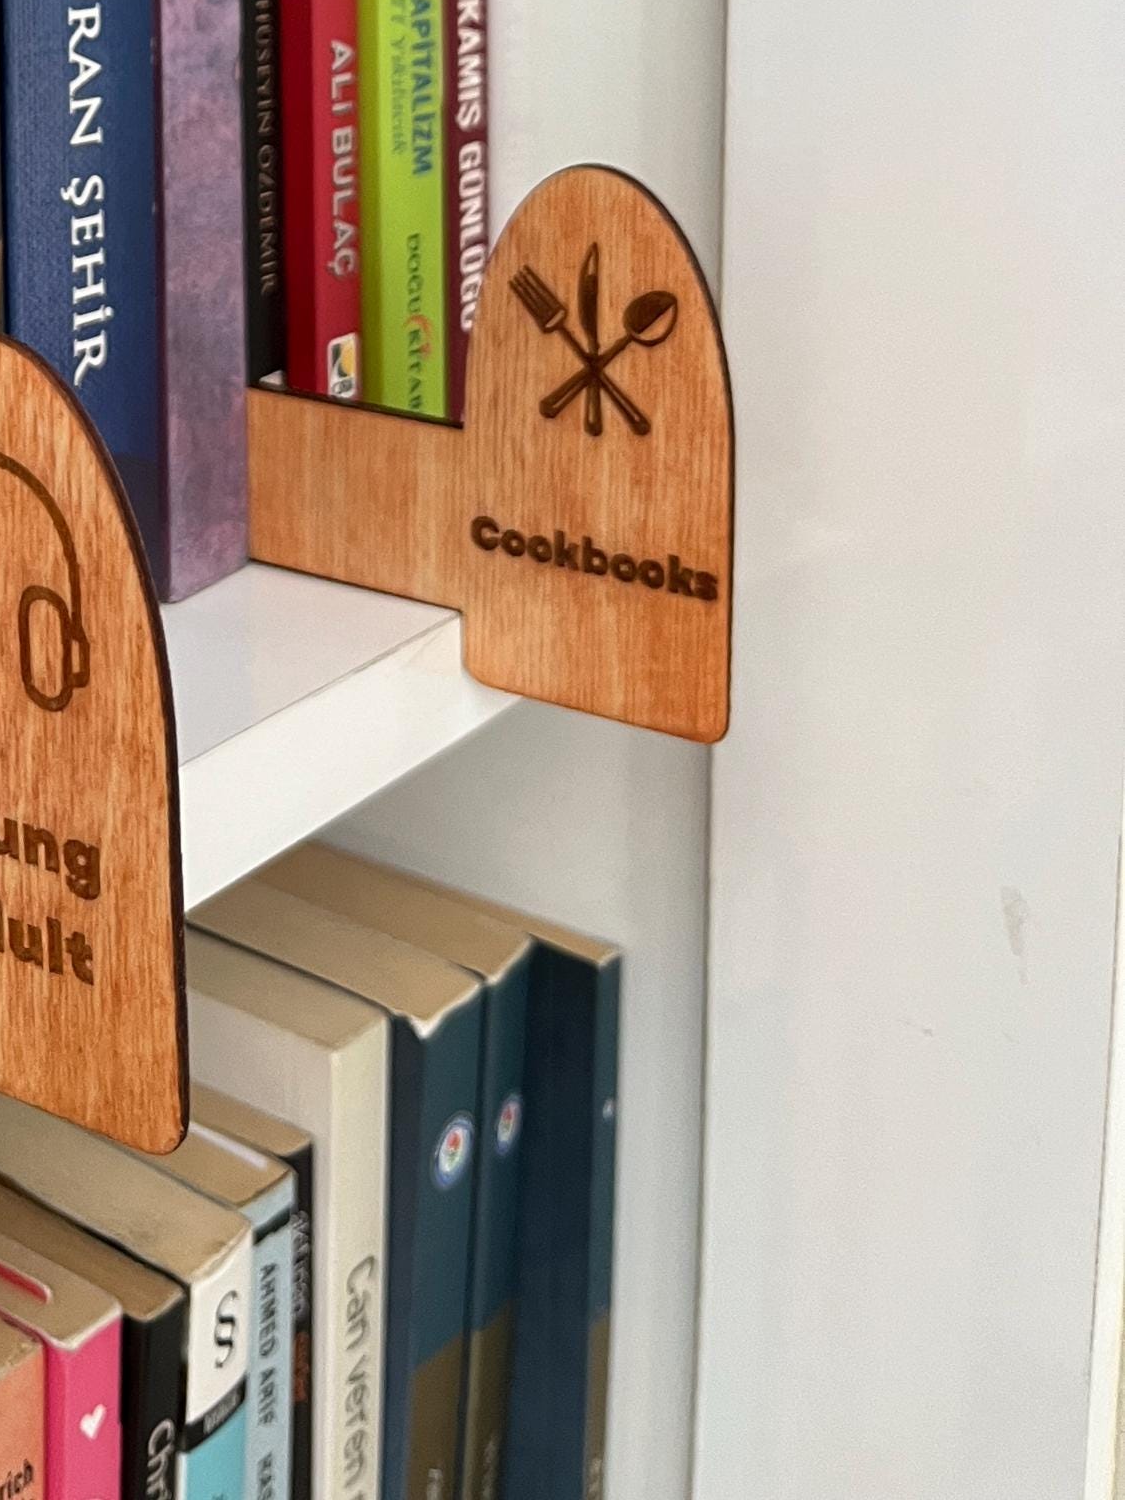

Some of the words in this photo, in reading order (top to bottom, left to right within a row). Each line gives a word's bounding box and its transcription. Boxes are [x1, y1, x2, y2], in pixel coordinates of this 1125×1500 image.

[325, 130, 359, 281] BULAÇ
[61, 174, 115, 389] ŞEHİR
[471, 515, 719, 602] Cookbooks
[345, 1254, 378, 1351] Can
[342, 1353, 372, 1488] veren
